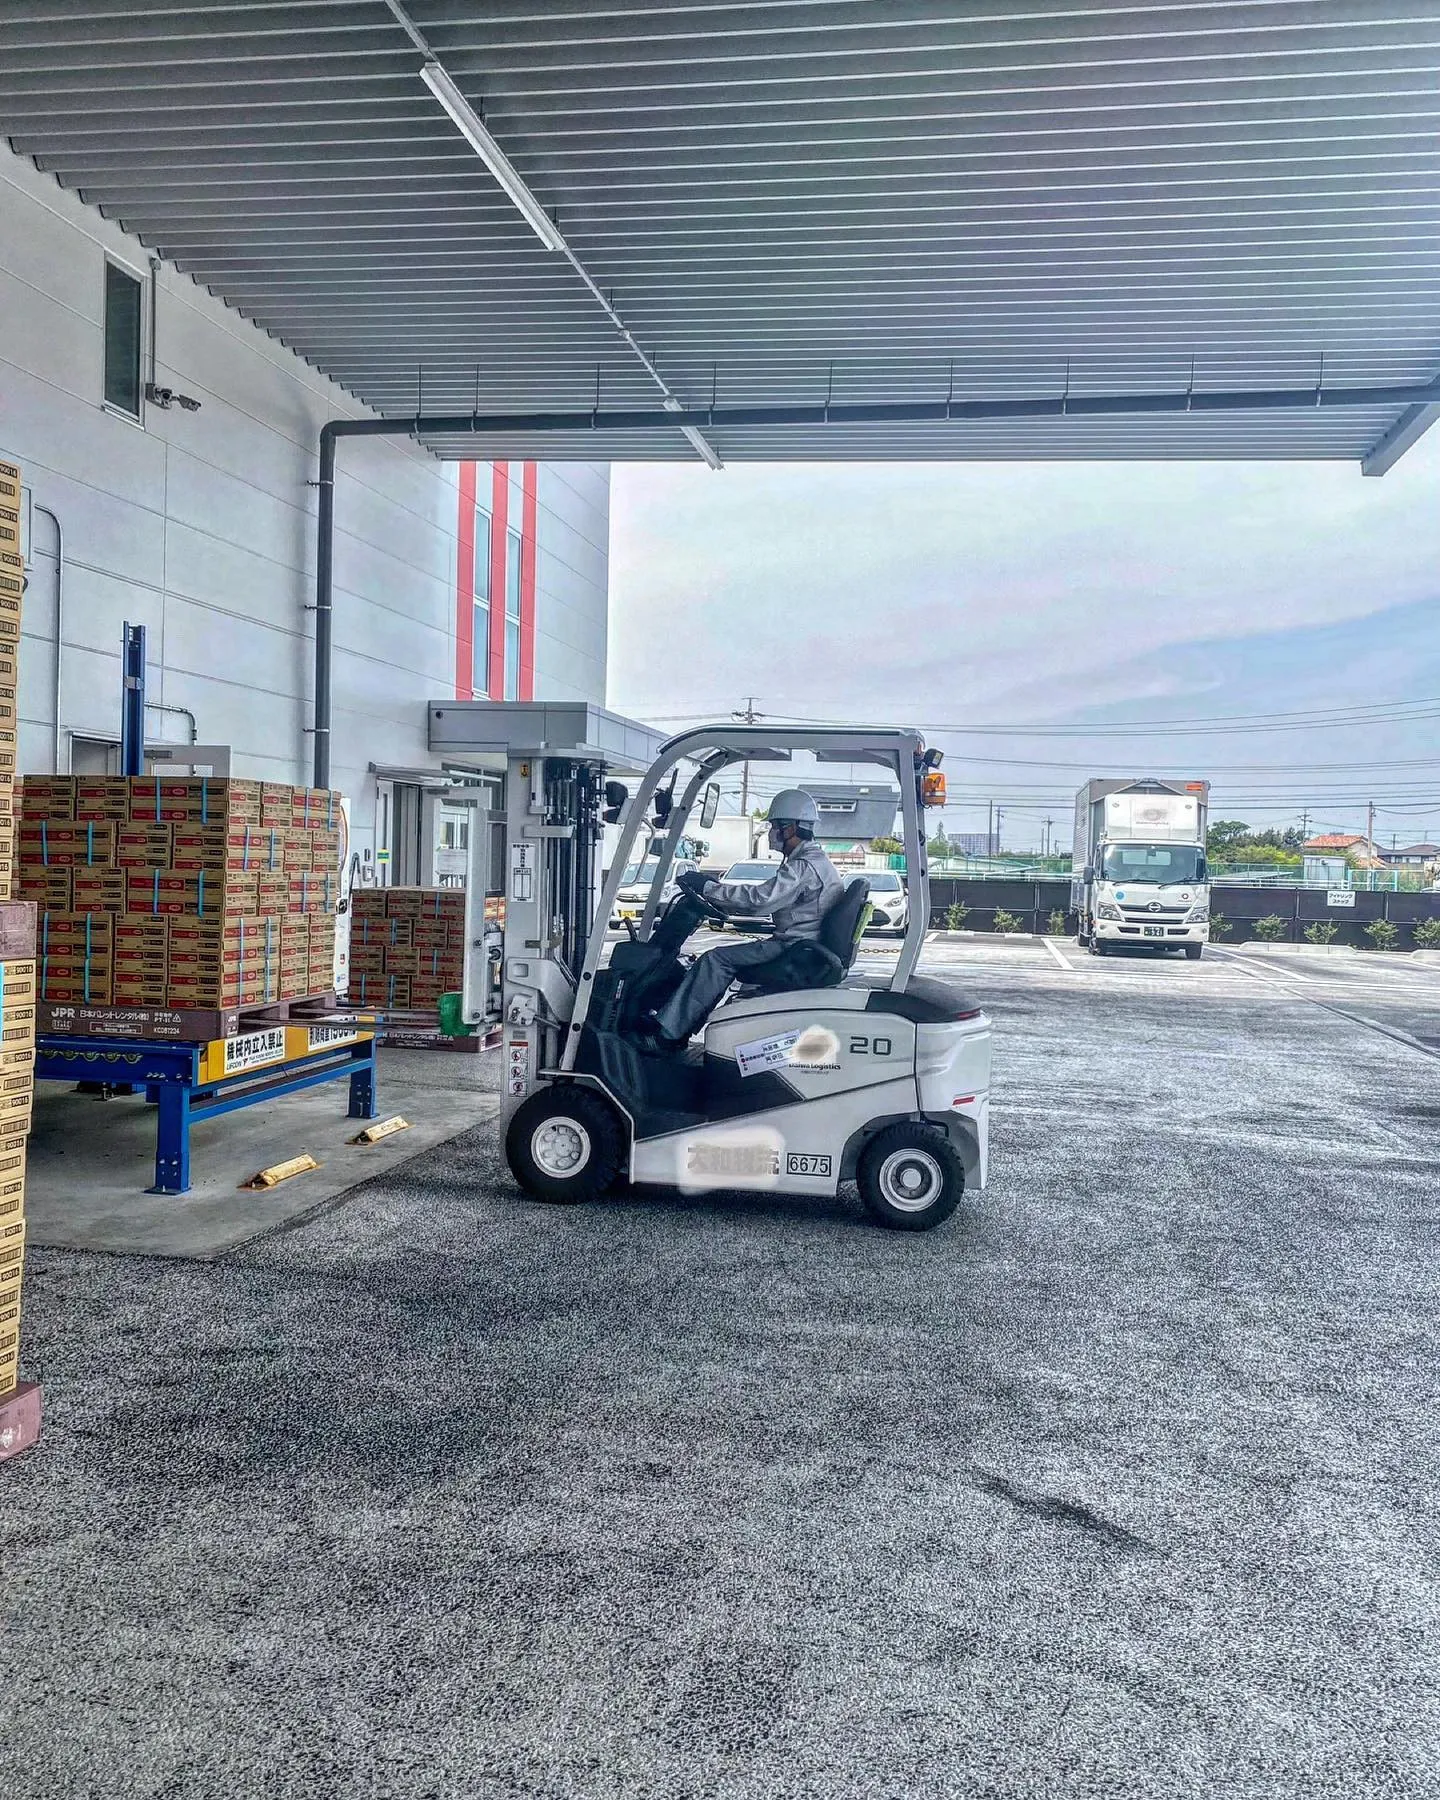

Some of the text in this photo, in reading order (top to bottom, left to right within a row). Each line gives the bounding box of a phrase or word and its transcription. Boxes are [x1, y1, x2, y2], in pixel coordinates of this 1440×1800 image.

[17, 966, 33, 974] 90016
[16, 1011, 32, 1020] 90016
[51, 1007, 75, 1018] JPR
[227, 1030, 283, 1060] 機械内立入禁止
[850, 1036, 892, 1056] 20
[16, 1052, 32, 1062] 90016
[811, 1063, 841, 1071] Logistics
[12, 1096, 28, 1107] 90016
[7, 1139, 23, 1150] 90016
[790, 1156, 828, 1173] 6675
[5, 1183, 21, 1194] 90016
[6, 1225, 21, 1237] 90016
[3, 1268, 18, 1281] 90016
